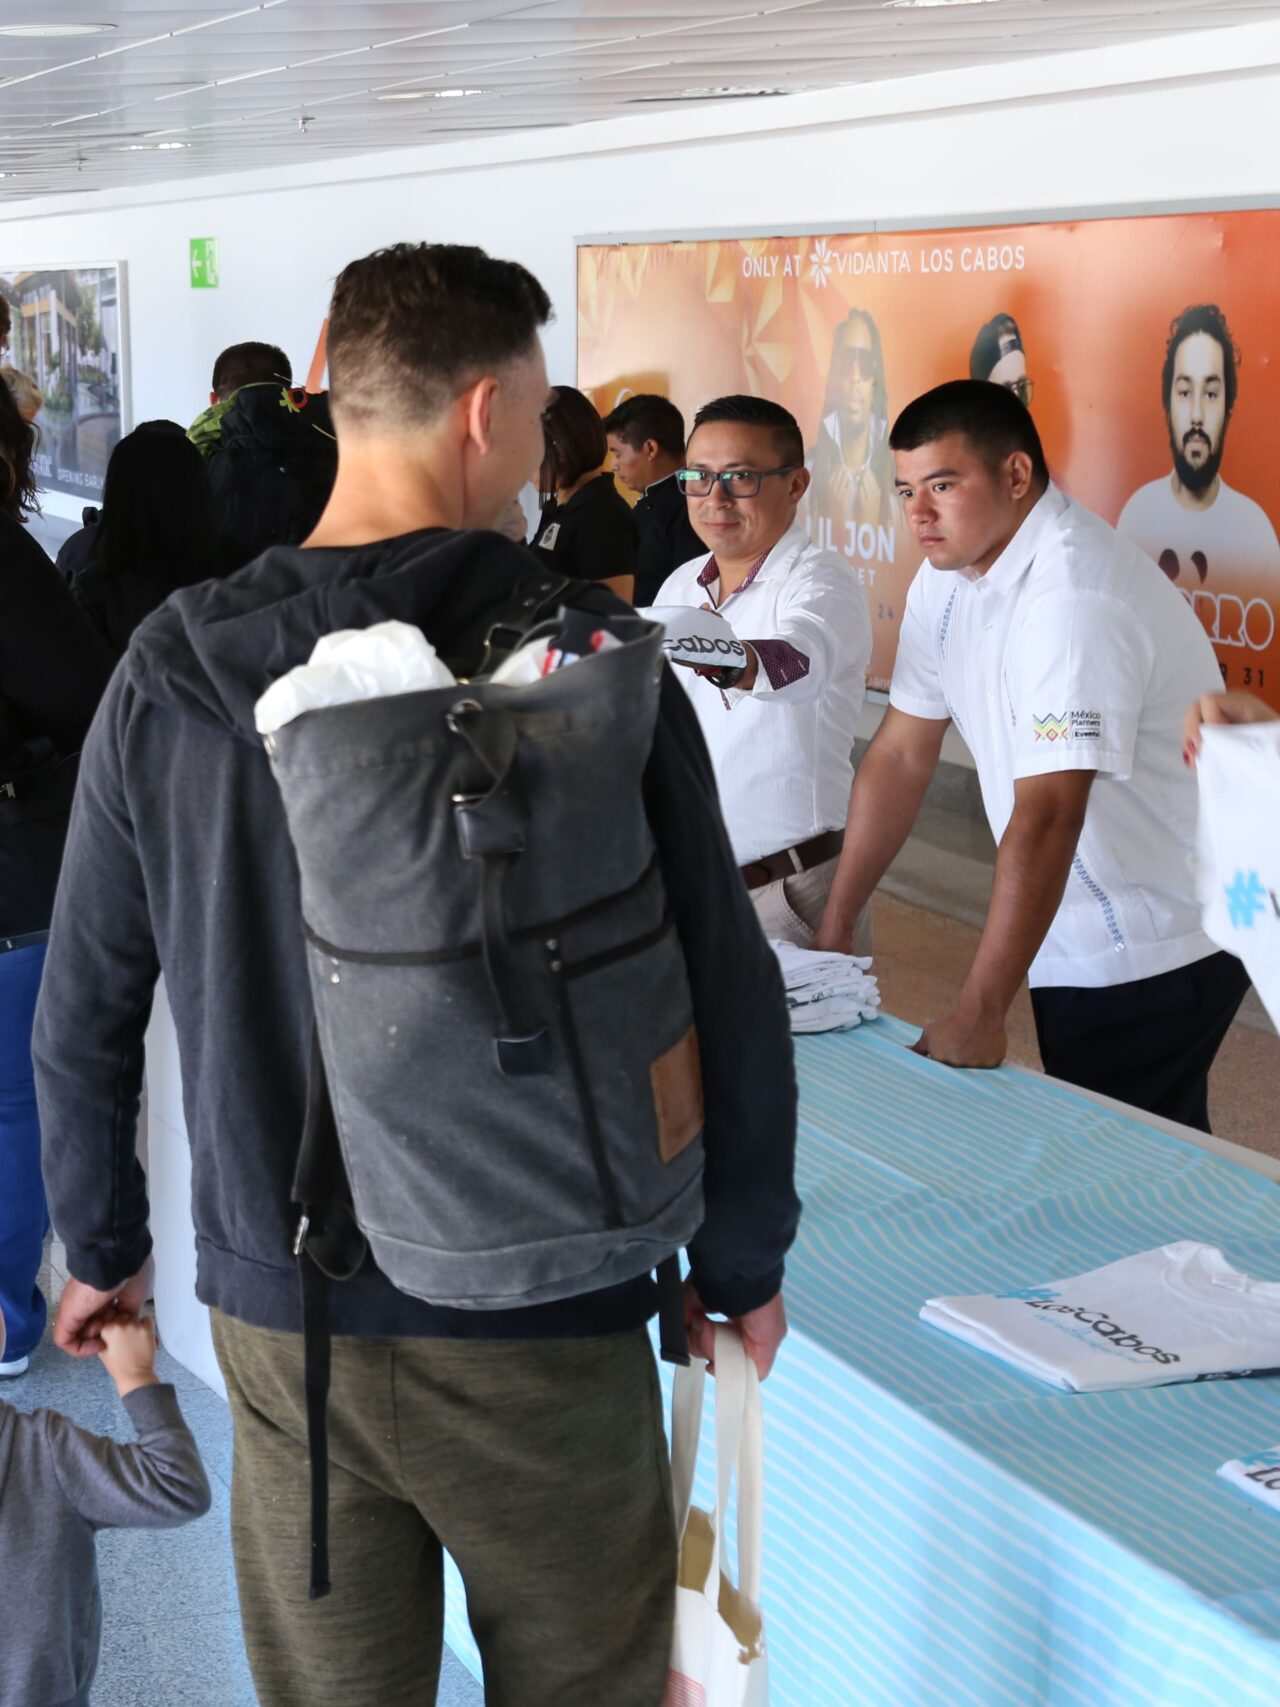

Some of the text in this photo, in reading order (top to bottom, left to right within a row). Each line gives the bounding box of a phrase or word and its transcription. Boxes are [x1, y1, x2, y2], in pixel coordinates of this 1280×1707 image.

[742, 245, 1025, 278] ONLY AT VIDANTA LOS CABOS
[843, 520, 896, 563] JON
[877, 603, 894, 620] 24
[1176, 587, 1274, 651] RRO
